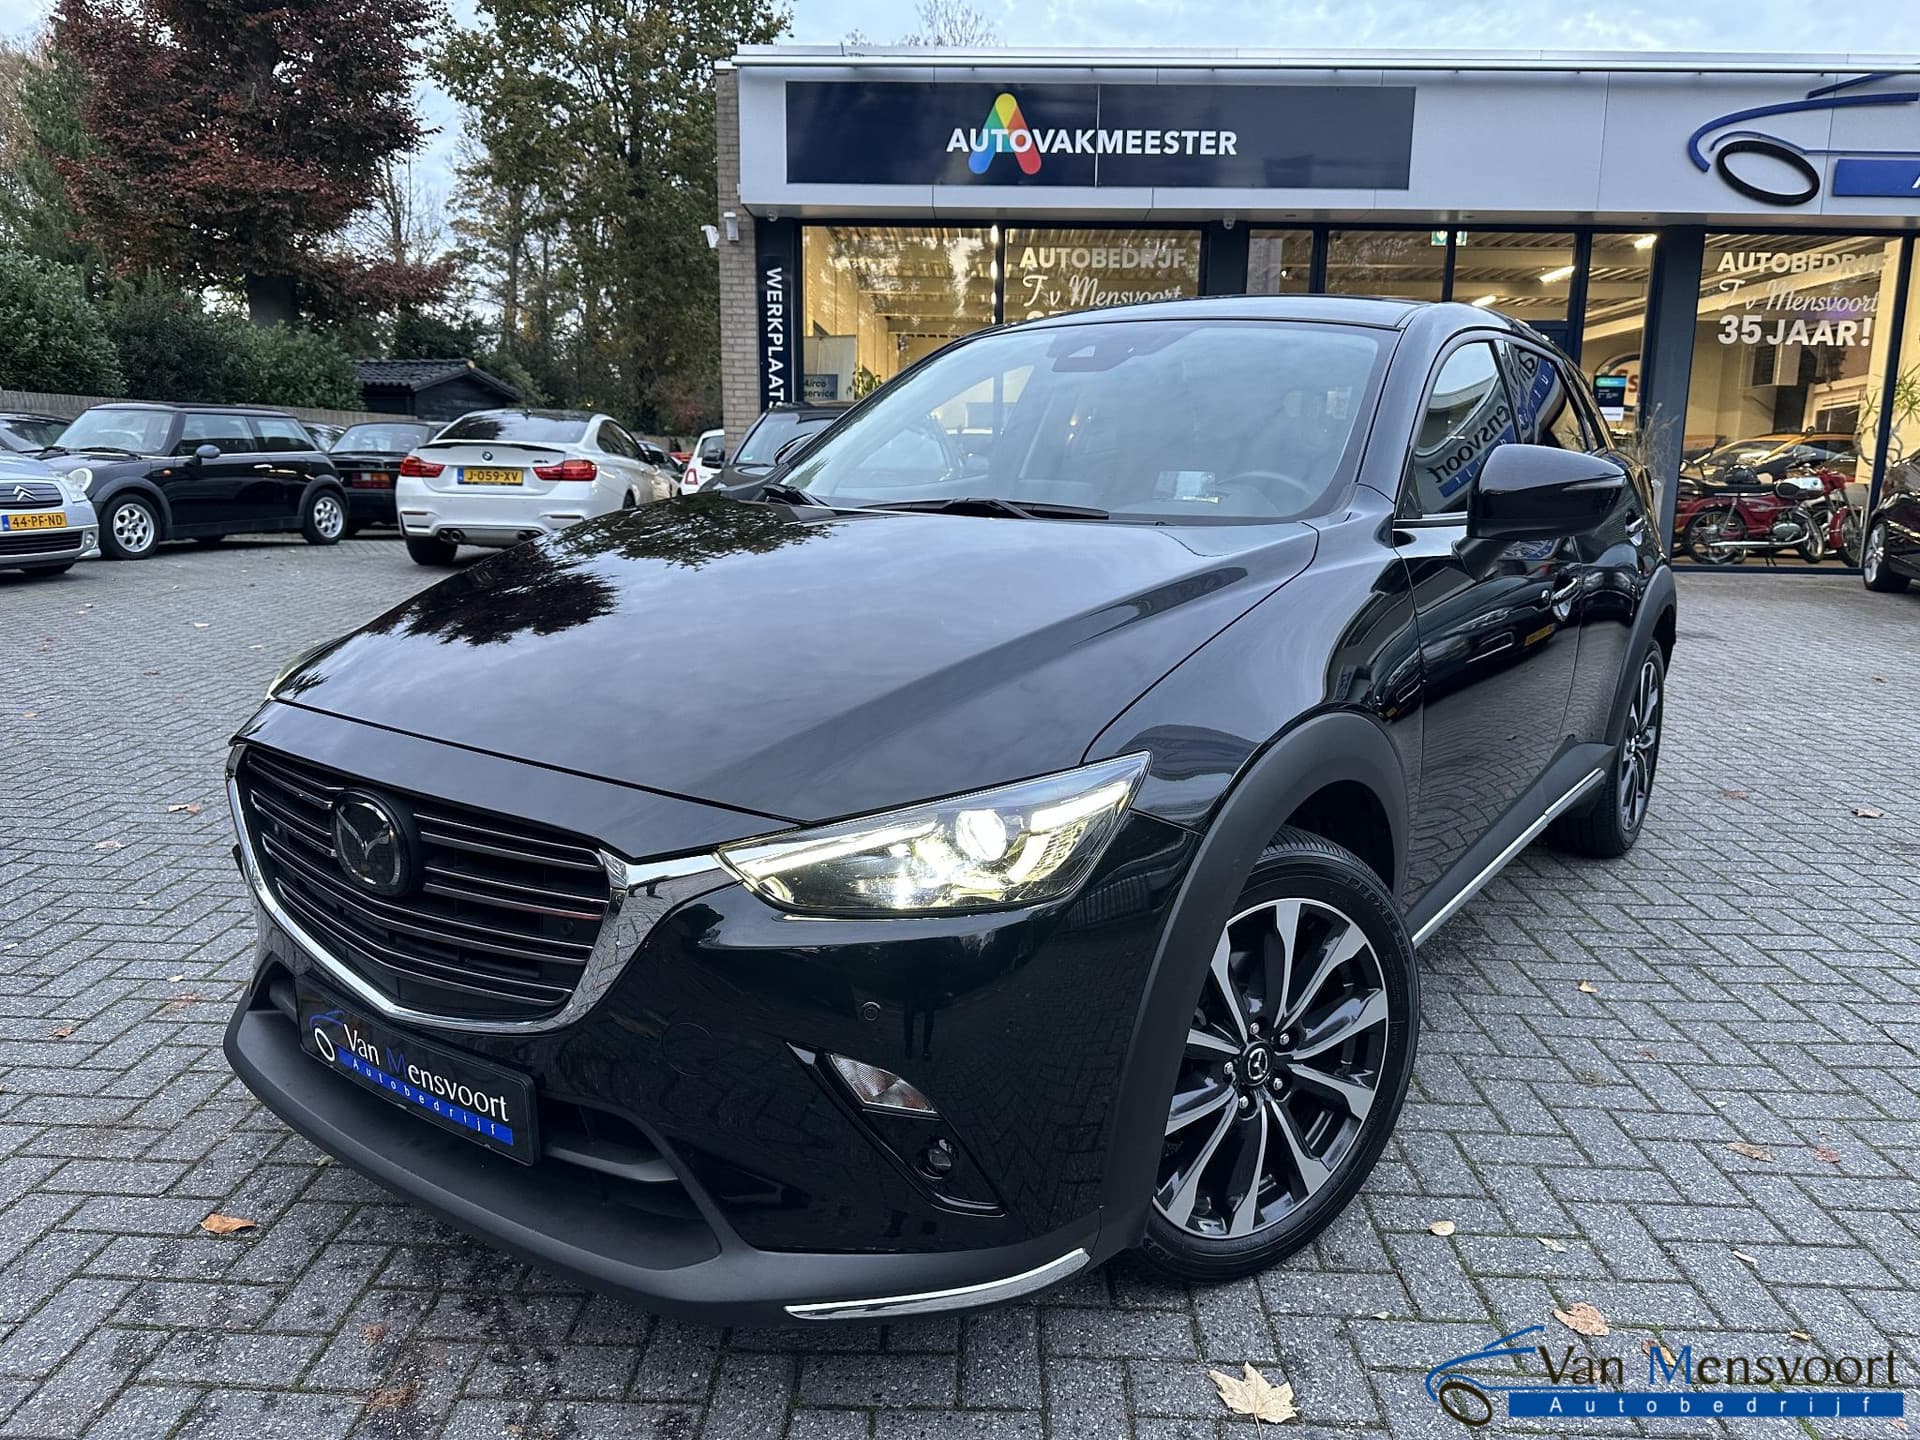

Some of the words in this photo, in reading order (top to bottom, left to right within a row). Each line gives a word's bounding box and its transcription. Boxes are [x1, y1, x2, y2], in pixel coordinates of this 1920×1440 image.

[946, 127, 1237, 156] AUTOVAKMEESTER
[1717, 315, 1762, 345] 35
[1766, 317, 1873, 347] JAAR!
[467, 470, 519, 481] J-059-XV
[12, 514, 63, 528] 44-PF-ND
[343, 1023, 380, 1066] Van
[385, 1046, 510, 1122] Mensvoort
[352, 1059, 496, 1136] Autobedrijf
